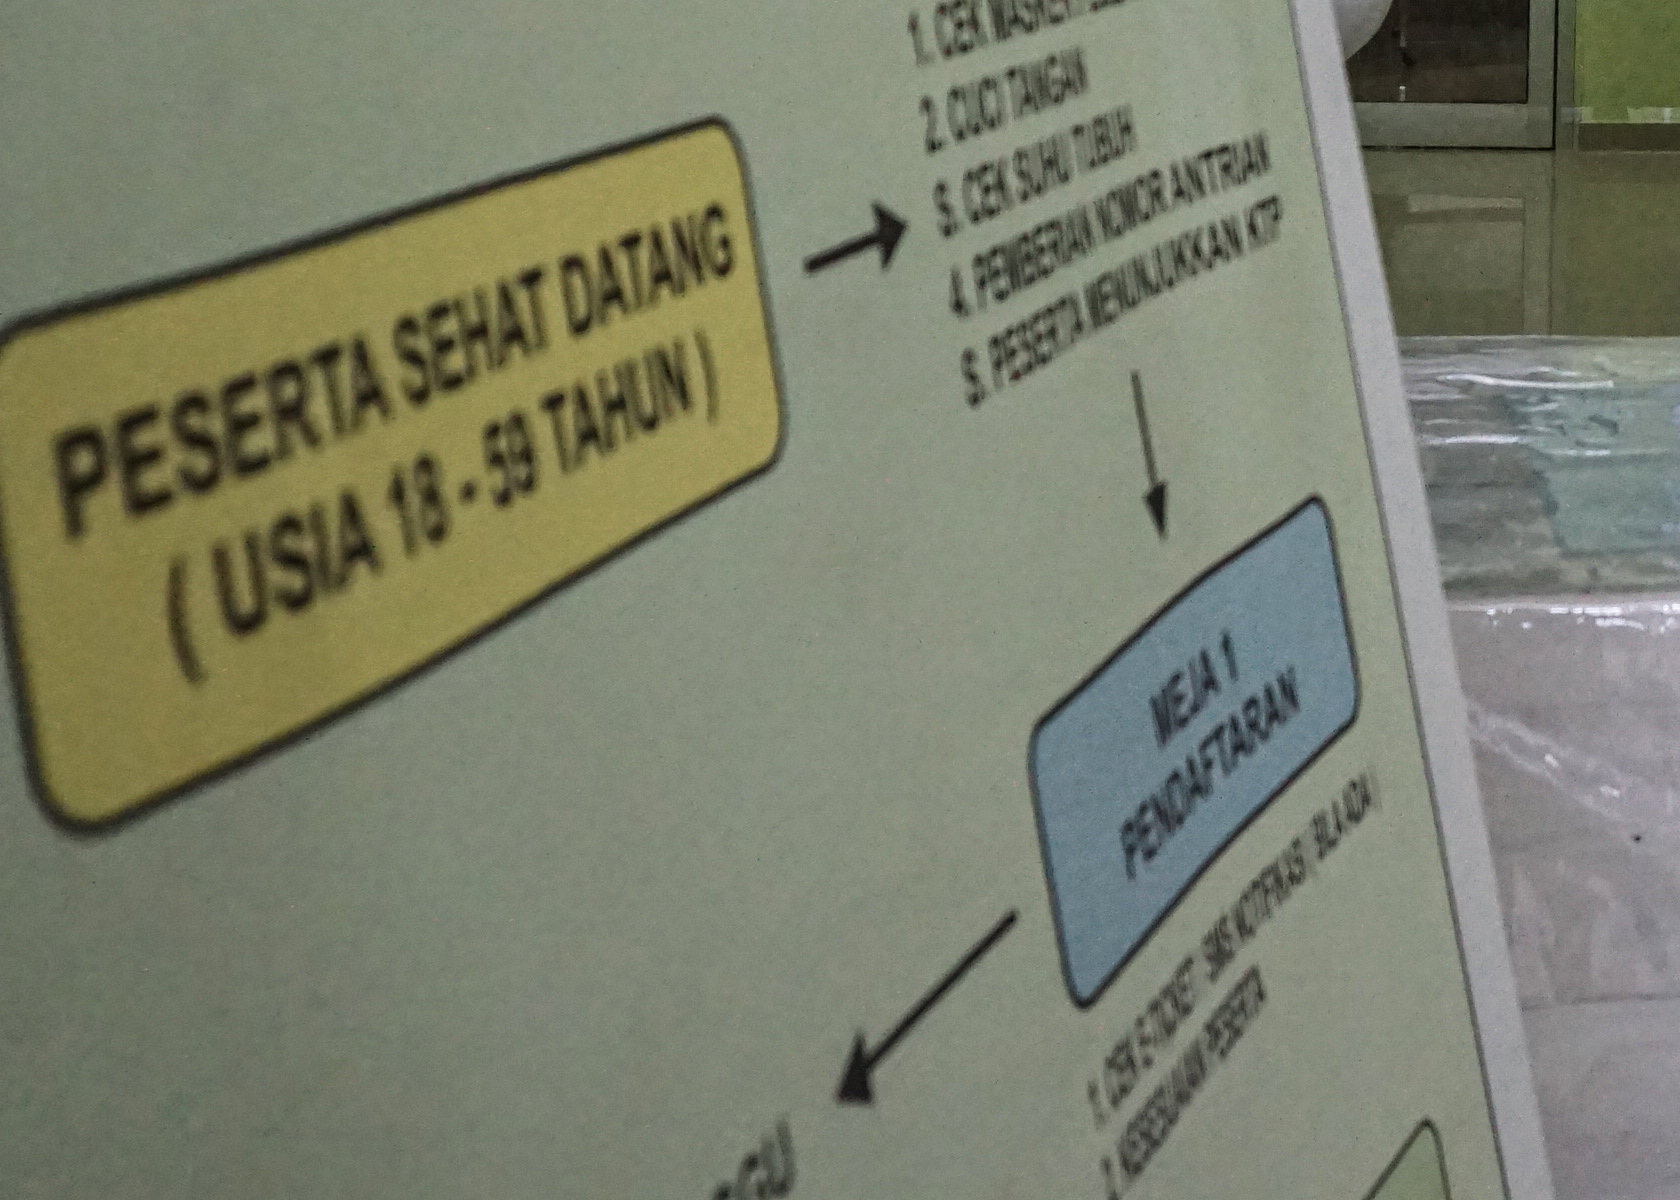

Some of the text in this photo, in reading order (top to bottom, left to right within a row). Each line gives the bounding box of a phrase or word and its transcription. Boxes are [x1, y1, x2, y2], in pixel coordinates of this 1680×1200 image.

[947, 75, 1005, 145] CUCI
[1005, 47, 1089, 120] TANGAN
[1012, 131, 1072, 202] SUHU
[1167, 128, 1272, 204] ANTRIAN
[53, 204, 736, 543] PESERTA SEHAT DATANG
[388, 455, 452, 555] 18
[481, 414, 537, 509] 59
[1150, 628, 1239, 747] MEJA 1
[1120, 664, 1301, 883] PENDAFTARAN
